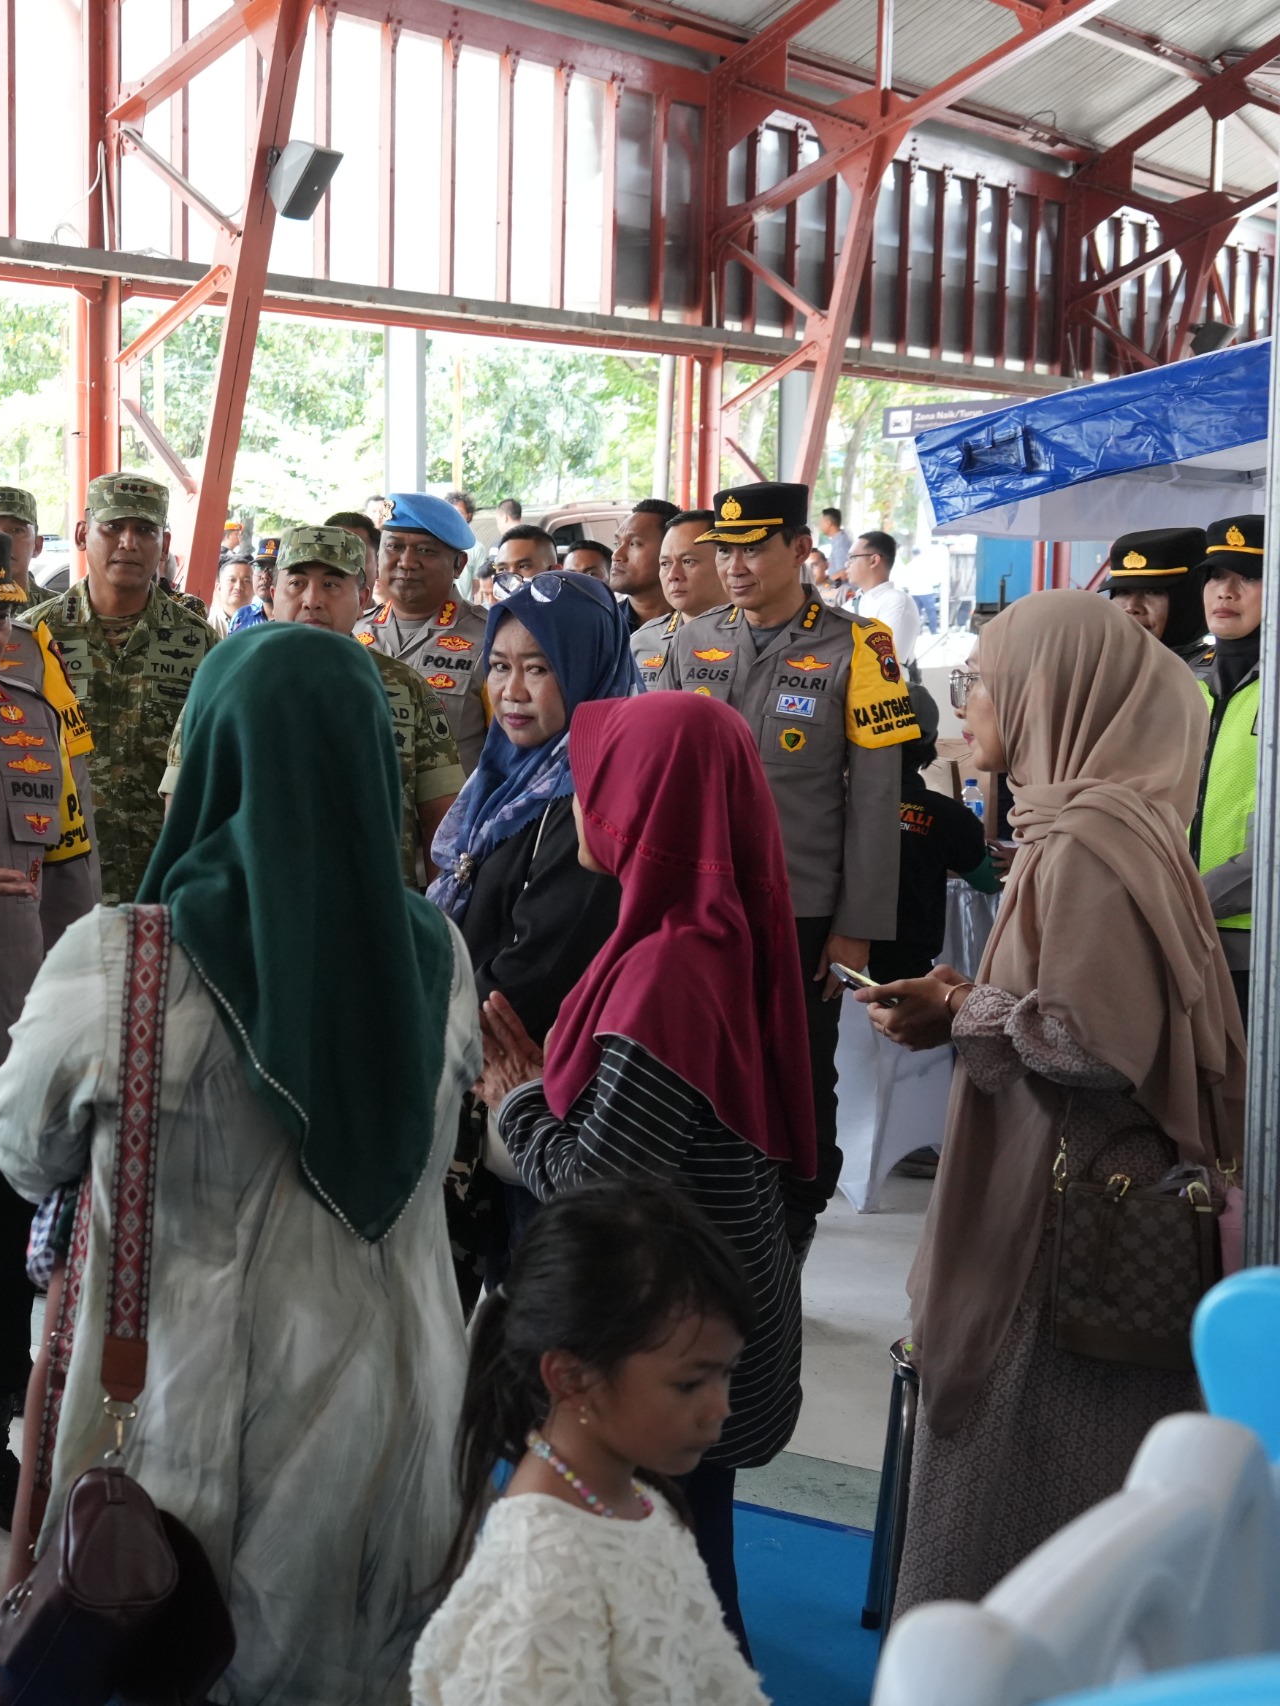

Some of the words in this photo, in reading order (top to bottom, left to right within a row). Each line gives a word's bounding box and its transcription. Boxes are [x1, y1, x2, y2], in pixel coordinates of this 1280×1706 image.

[151, 662, 175, 674] TNI
[423, 654, 472, 671] POLRI
[686, 667, 730, 682] AGUS
[777, 675, 827, 692] POLRI
[780, 696, 813, 711] DVI
[61, 706, 80, 731] KA
[853, 707, 872, 729] KA
[11, 781, 54, 800] POLRI
